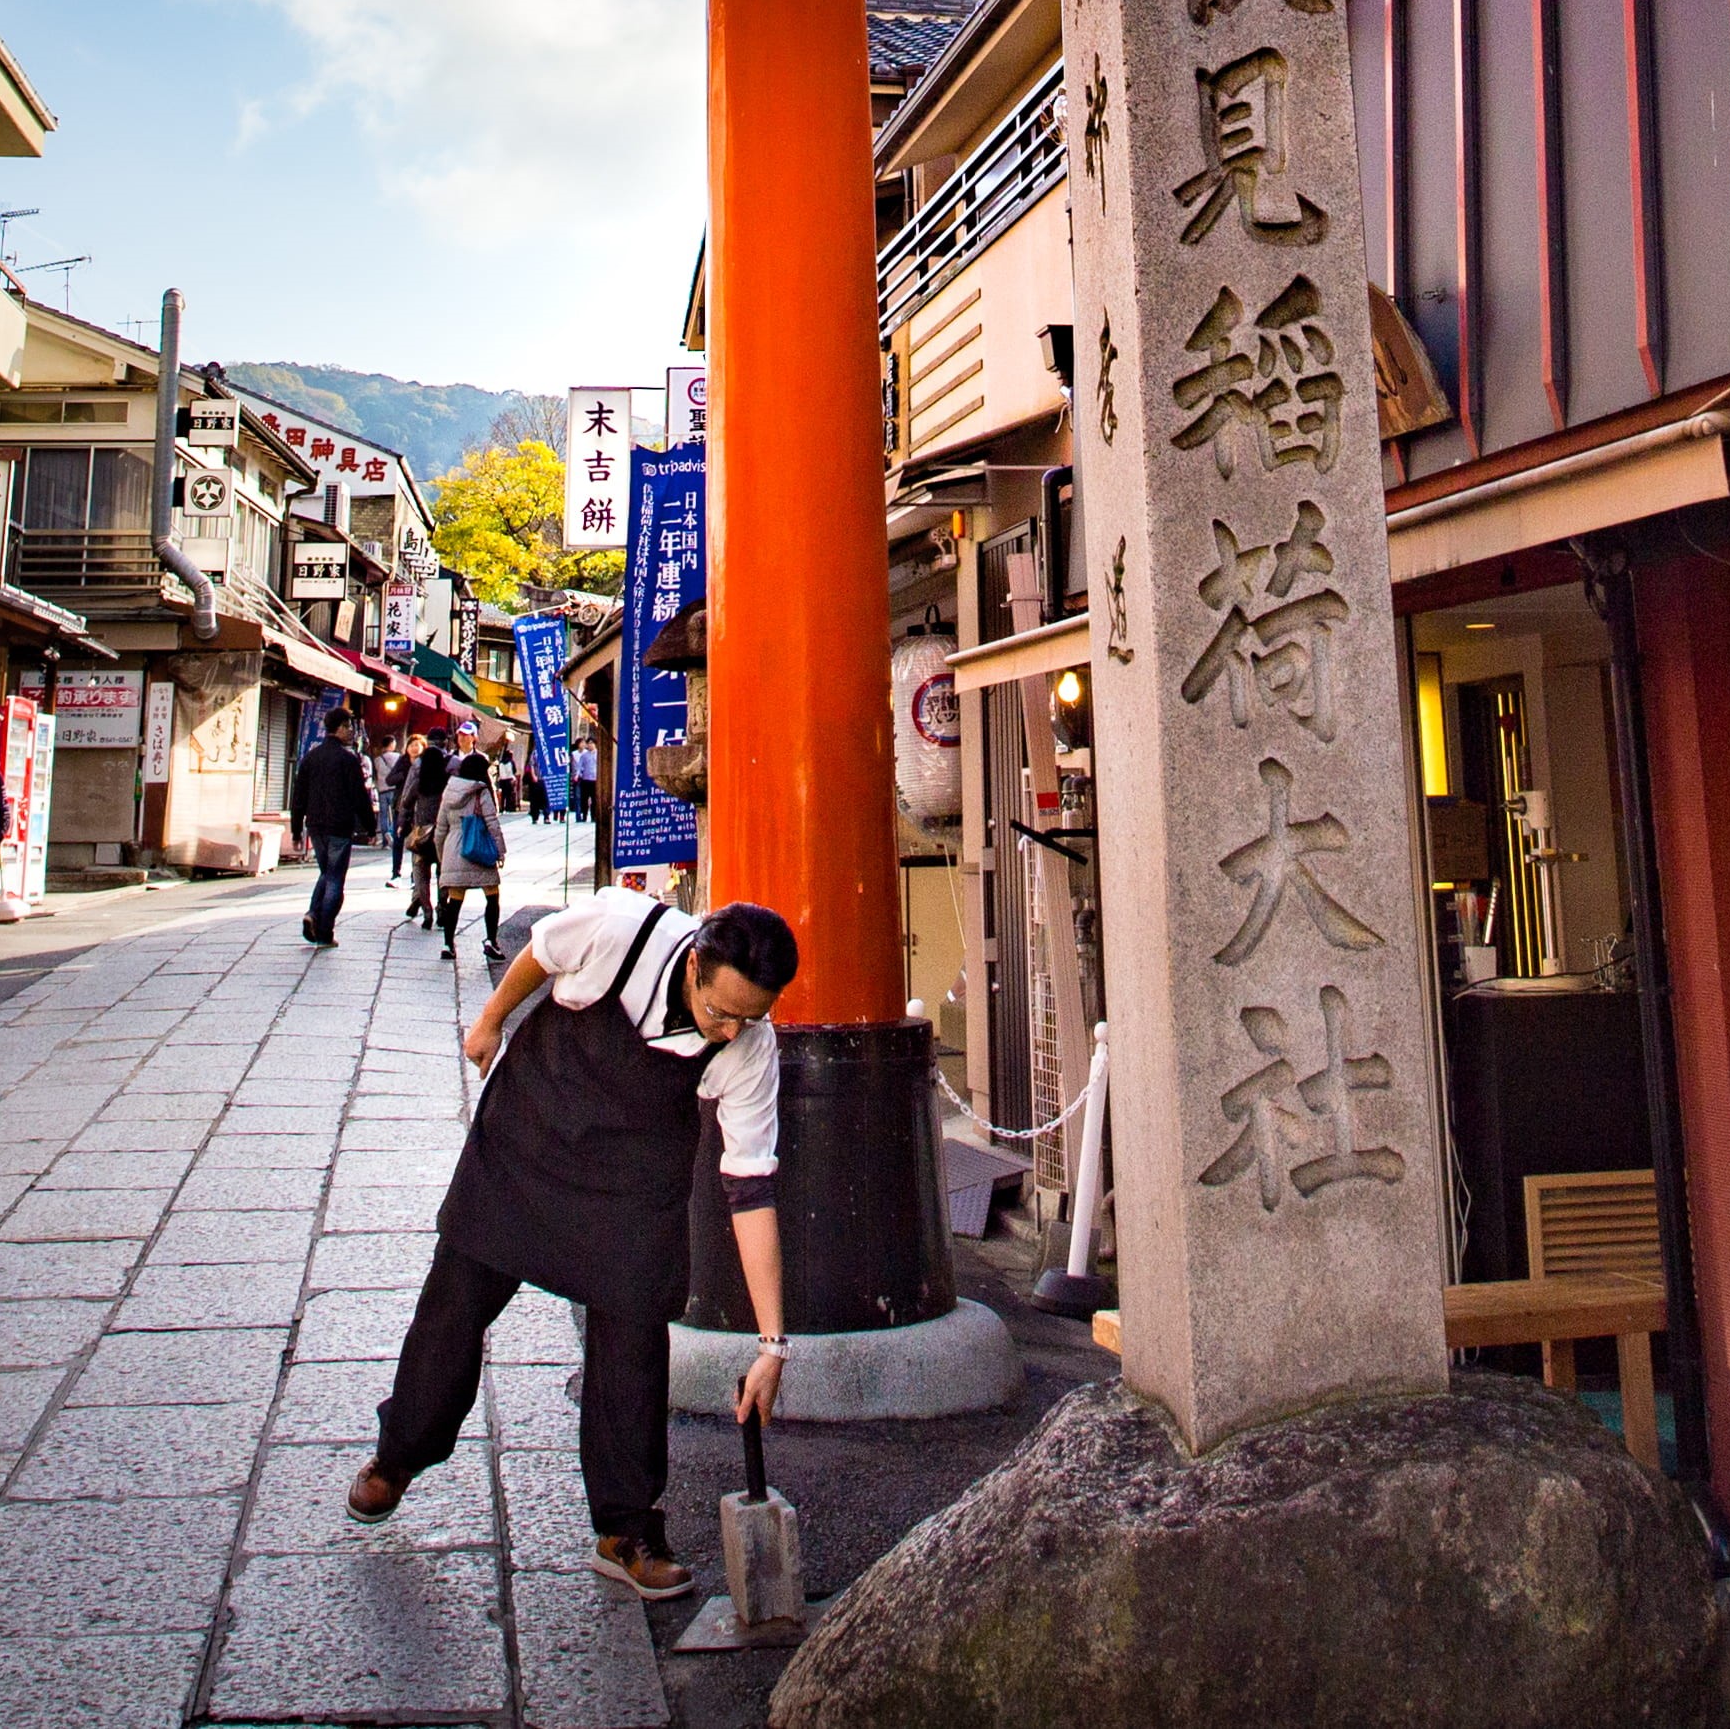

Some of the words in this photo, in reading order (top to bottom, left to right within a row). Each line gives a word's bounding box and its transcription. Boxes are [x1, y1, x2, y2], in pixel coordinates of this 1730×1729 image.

[193, 418, 233, 429] 日野家
[580, 400, 617, 533] 末吉餅
[681, 491, 698, 570] 日本国内
[298, 564, 341, 578] 日野家
[652, 499, 683, 623] 二年連続
[386, 601, 403, 638] 花家
[533, 641, 554, 700] 二年連続
[544, 704, 570, 767] 第一位
[62, 729, 98, 743] 日野家
